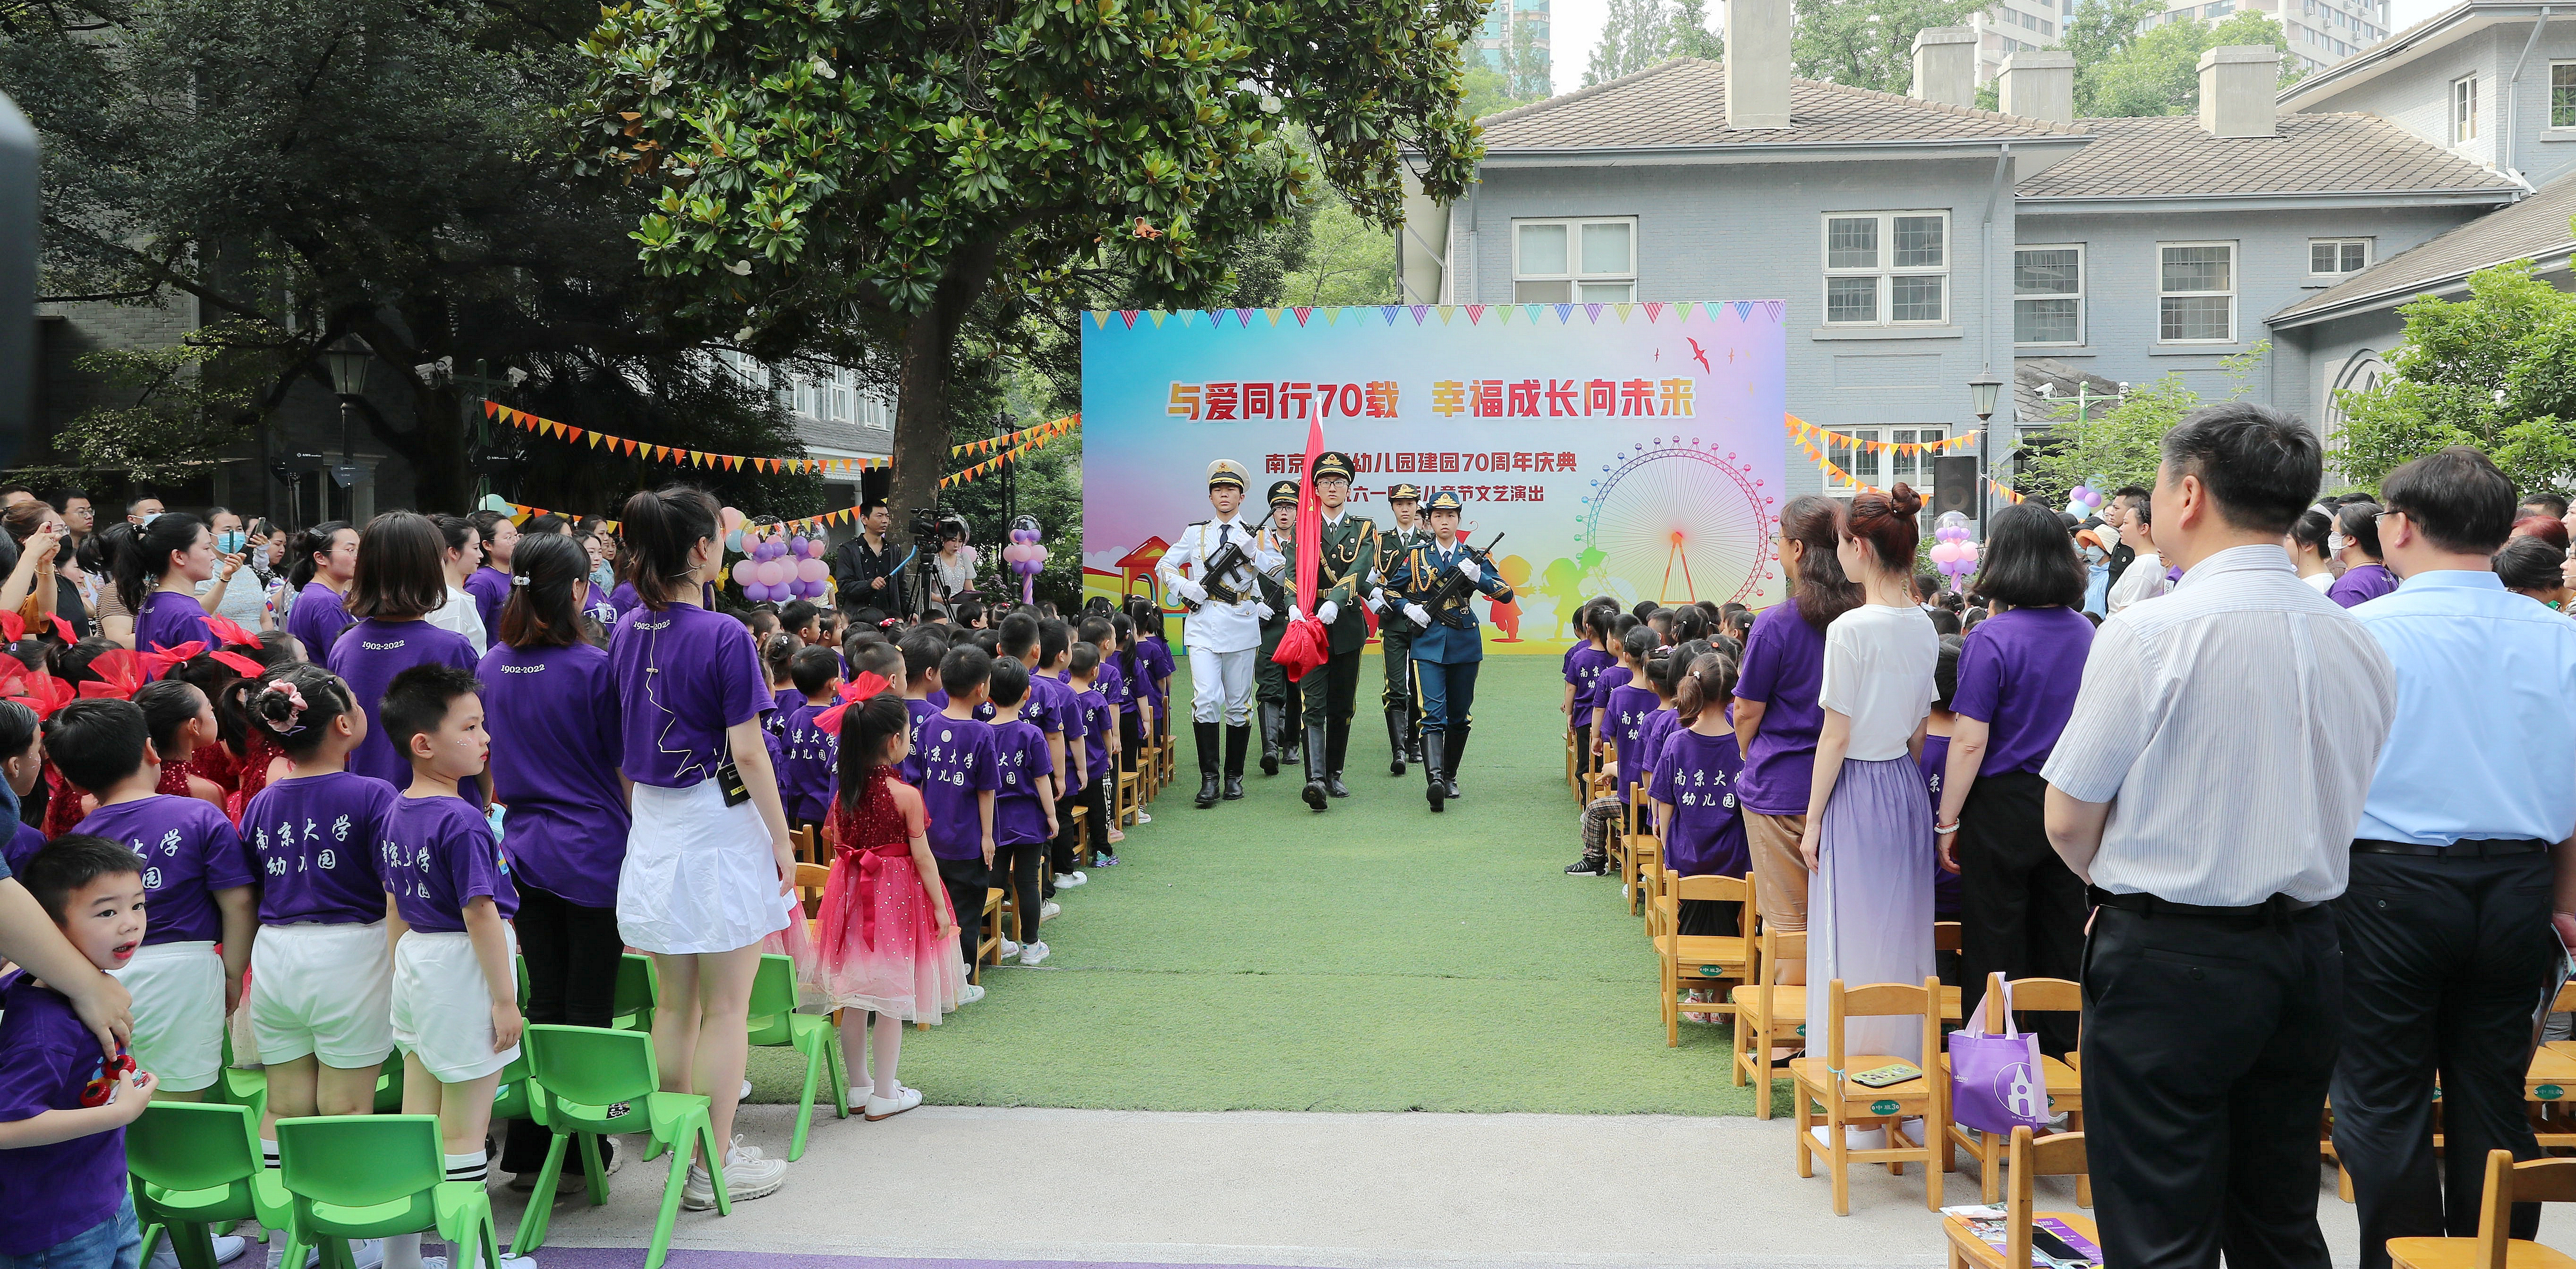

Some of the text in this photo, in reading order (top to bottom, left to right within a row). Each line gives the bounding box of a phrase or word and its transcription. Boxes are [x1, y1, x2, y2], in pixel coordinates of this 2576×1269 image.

[1167, 378, 1695, 421] 与爱同行70载 幸福成长向未来
[1266, 452, 1576, 474] 南京幼儿园建园70周年庆典
[633, 619, 671, 630] 1902-2022
[362, 639, 405, 650] 1902-2022
[501, 664, 545, 674] 1902-2022
[1086, 709, 1094, 722] 学
[1006, 771, 1015, 784] 园
[1682, 792, 1735, 808] 幼儿园
[256, 814, 351, 851] 南京大学
[142, 867, 162, 889] 园
